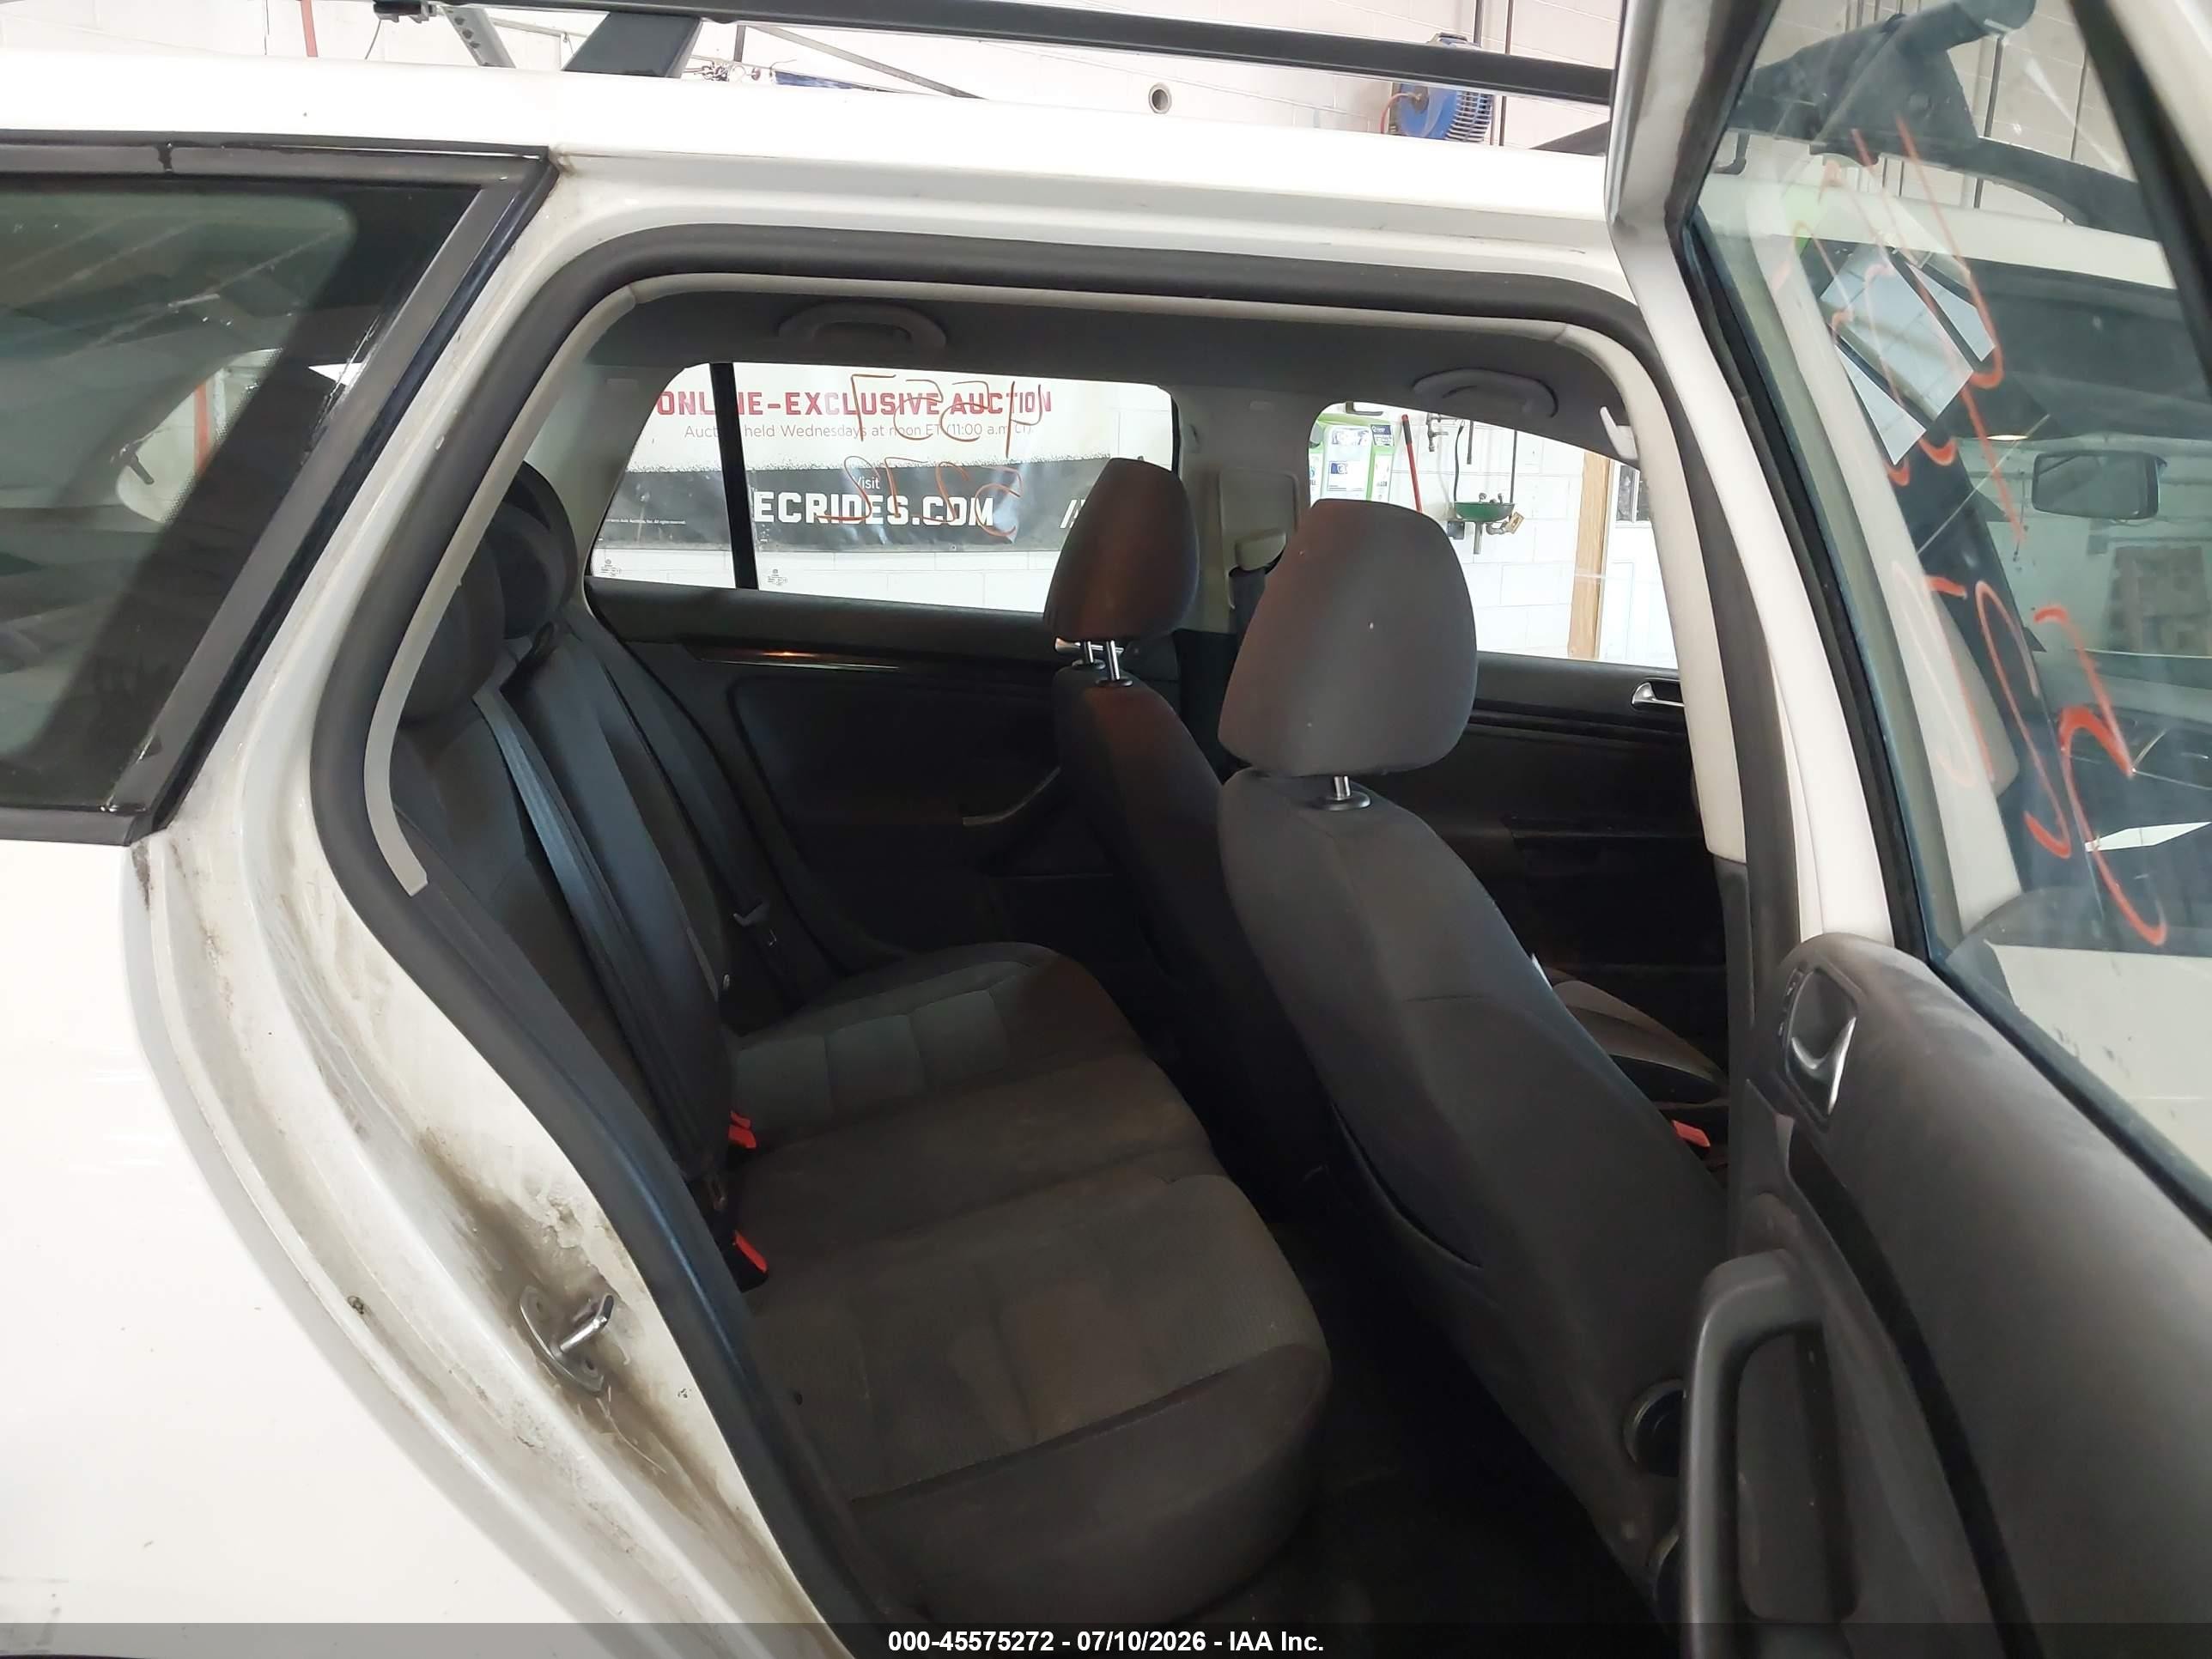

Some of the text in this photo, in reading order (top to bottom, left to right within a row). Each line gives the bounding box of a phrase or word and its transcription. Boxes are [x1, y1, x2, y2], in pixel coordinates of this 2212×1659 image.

[656, 392, 1052, 416] ONLE-EXCLUSIVE AUCTION
[684, 424, 718, 438] Auct
[744, 424, 775, 438] held
[781, 424, 866, 441] Wednesdays
[872, 425, 885, 436] at
[889, 425, 921, 436] noon
[926, 423, 943, 436] ET
[852, 476, 880, 489] Visit
[753, 491, 994, 526] ECRIDES.COM
